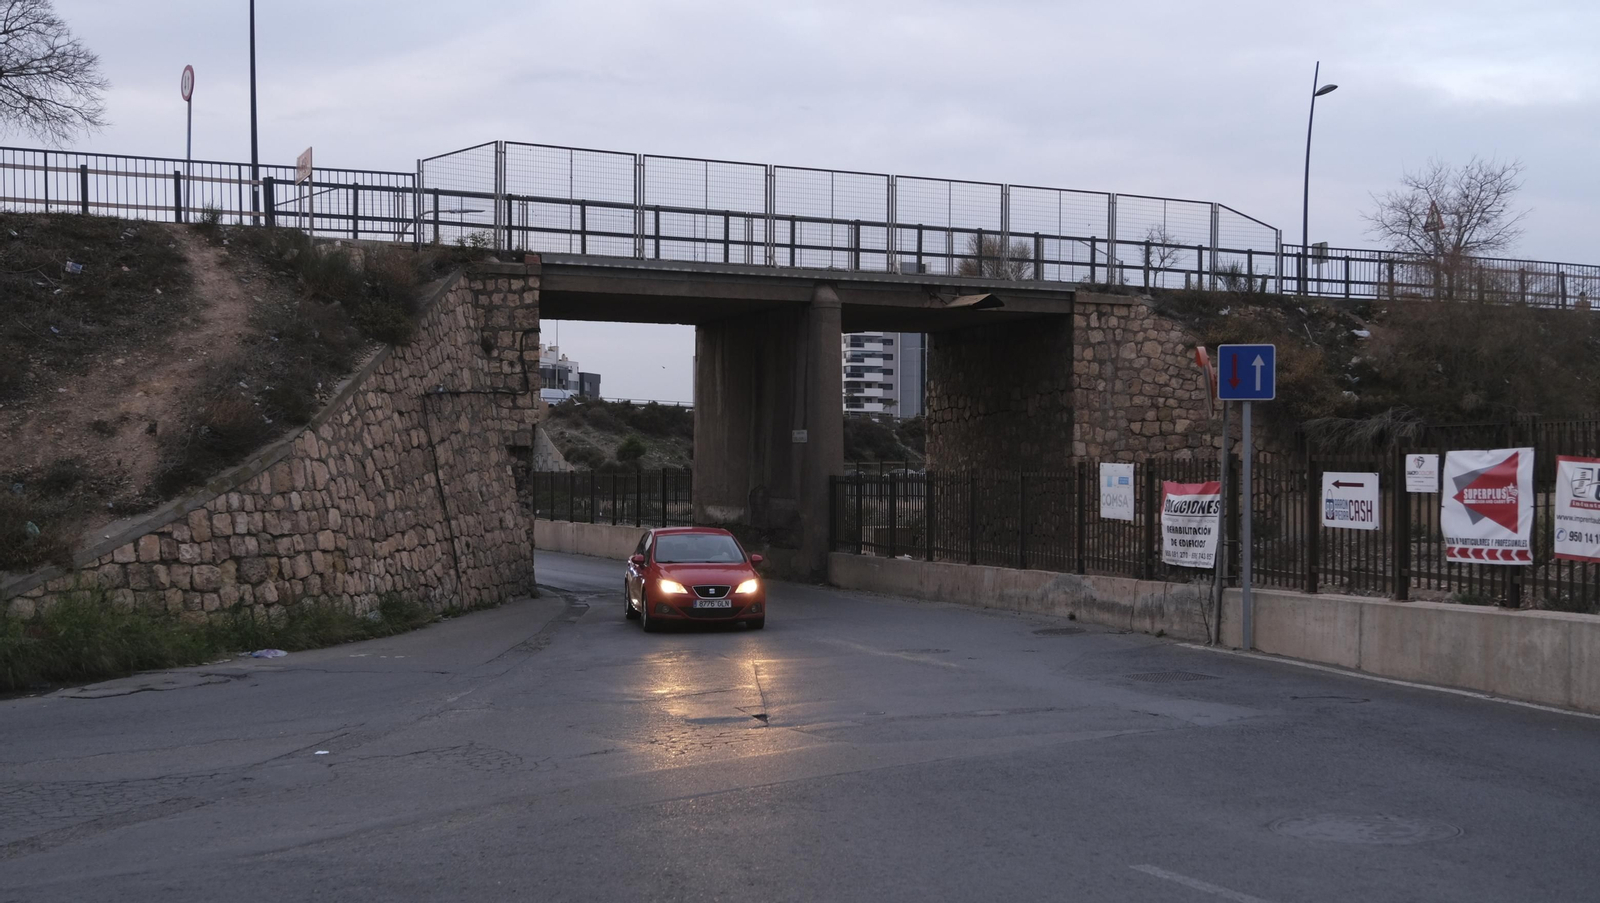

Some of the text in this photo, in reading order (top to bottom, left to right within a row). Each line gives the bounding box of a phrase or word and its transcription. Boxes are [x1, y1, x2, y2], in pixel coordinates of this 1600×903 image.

[1463, 487, 1507, 500] SUPERPLUS
[1102, 494, 1129, 508] COMSA
[1165, 499, 1220, 514] SOLUCIONES
[1349, 499, 1373, 522] CASH
[1167, 525, 1212, 535] REHABILITACIÓN
[1459, 538, 1490, 546] PARTICULARES
[1495, 539, 1528, 547] PROFESIONALES
[1568, 531, 1582, 543] 950
[1585, 532, 1593, 543] 14
[1171, 539, 1206, 548] DE EDIFICIOS
